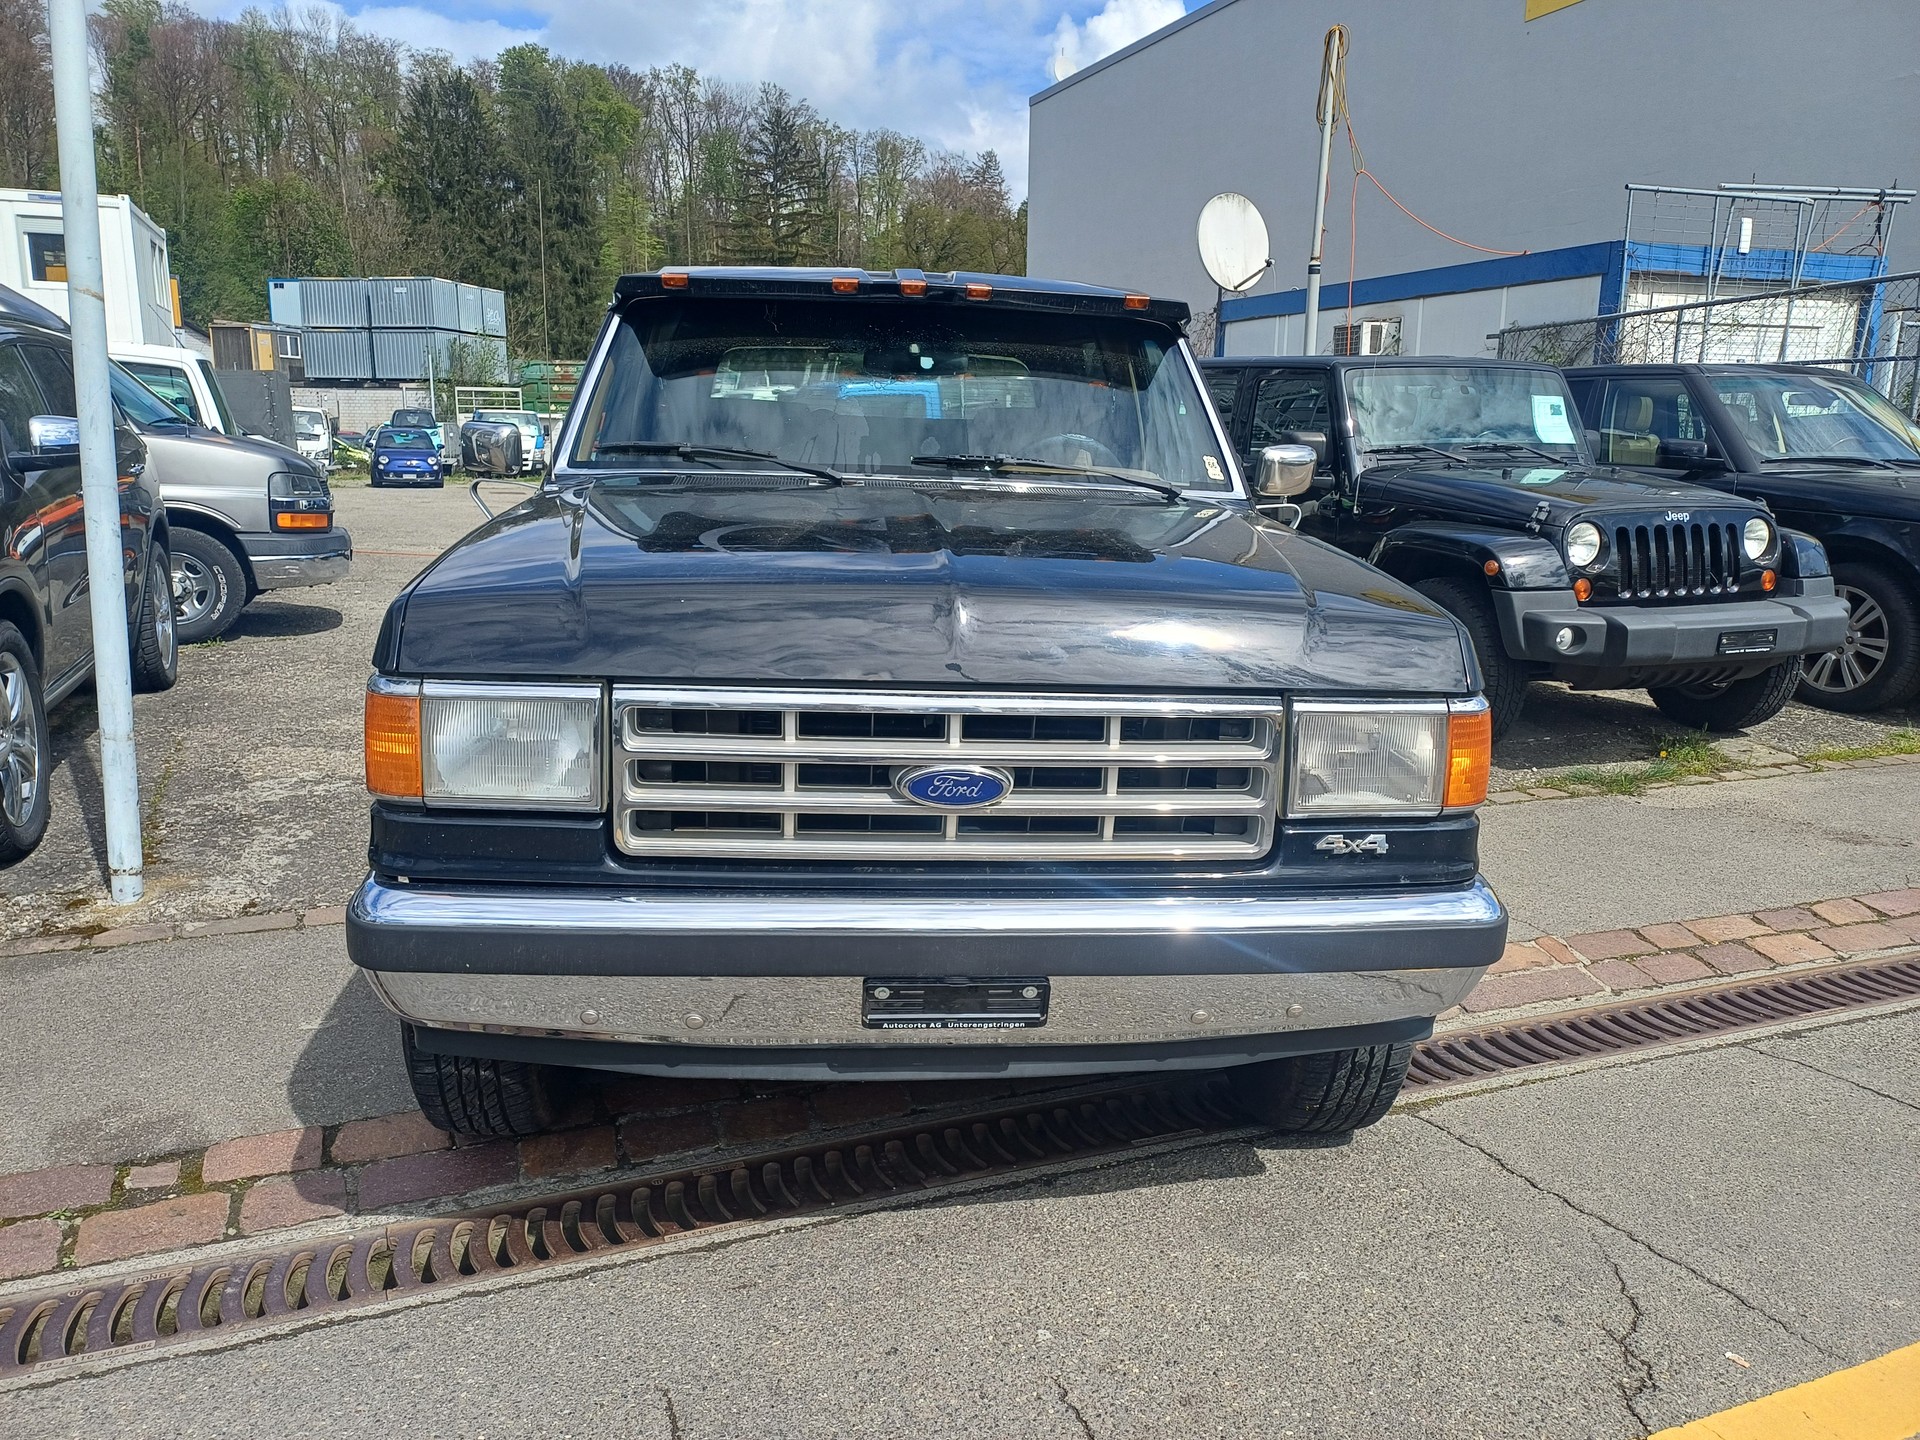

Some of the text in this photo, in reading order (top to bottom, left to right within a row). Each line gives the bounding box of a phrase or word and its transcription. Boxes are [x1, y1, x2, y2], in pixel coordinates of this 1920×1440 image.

[1665, 511, 1690, 523] Jeep
[210, 565, 228, 621] COOPER
[927, 775, 983, 798] Ford
[1313, 833, 1389, 854] 4x4
[947, 1021, 1026, 1029] Unterengstringen
